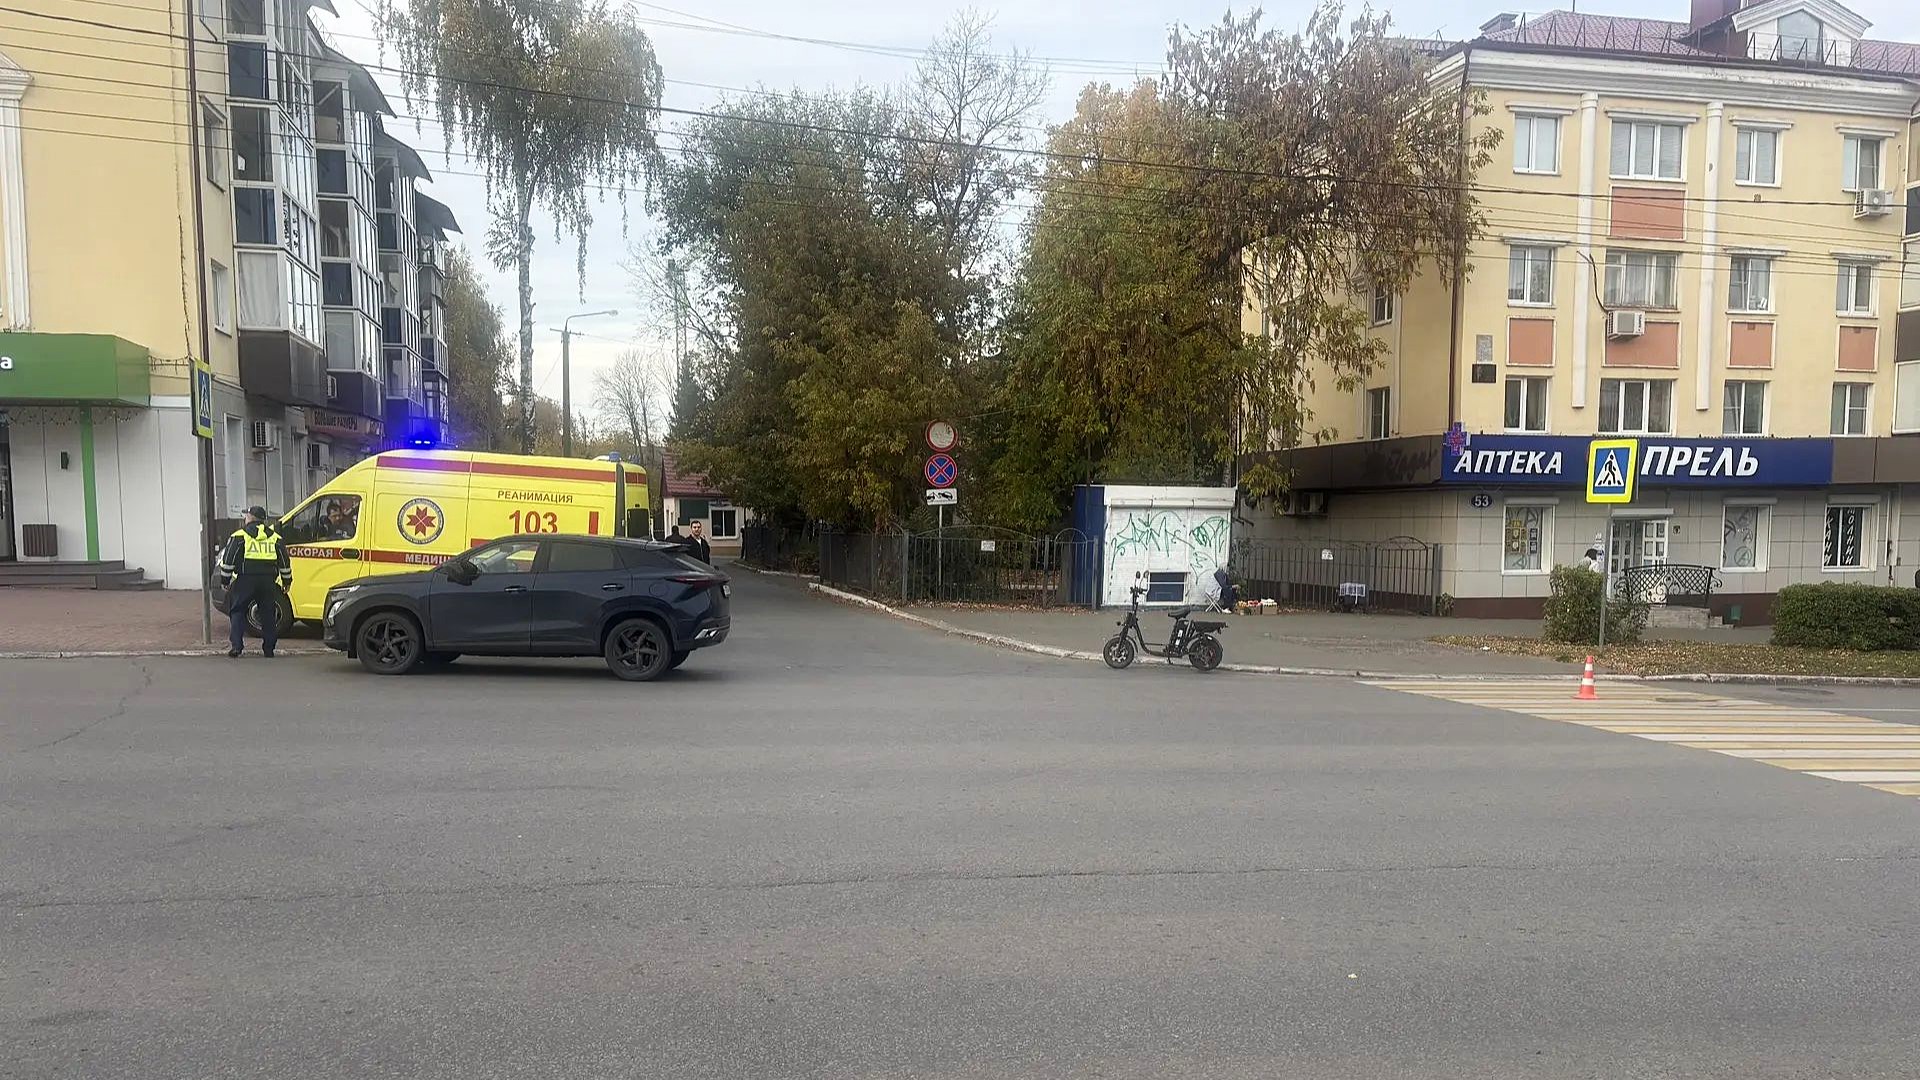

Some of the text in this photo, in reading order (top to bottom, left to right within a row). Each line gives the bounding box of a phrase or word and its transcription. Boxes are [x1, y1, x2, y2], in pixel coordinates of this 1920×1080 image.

[1454, 450, 1562, 474] АПТЕКА
[1640, 446, 1759, 476] ПРЕЛЬ
[497, 490, 573, 503] РЕАНИМАЦИЯ
[1474, 495, 1489, 507] 53
[508, 510, 558, 534] 103
[247, 541, 276, 553] ДПС
[289, 547, 451, 565] СКОРАЯ МЕДИЦ
